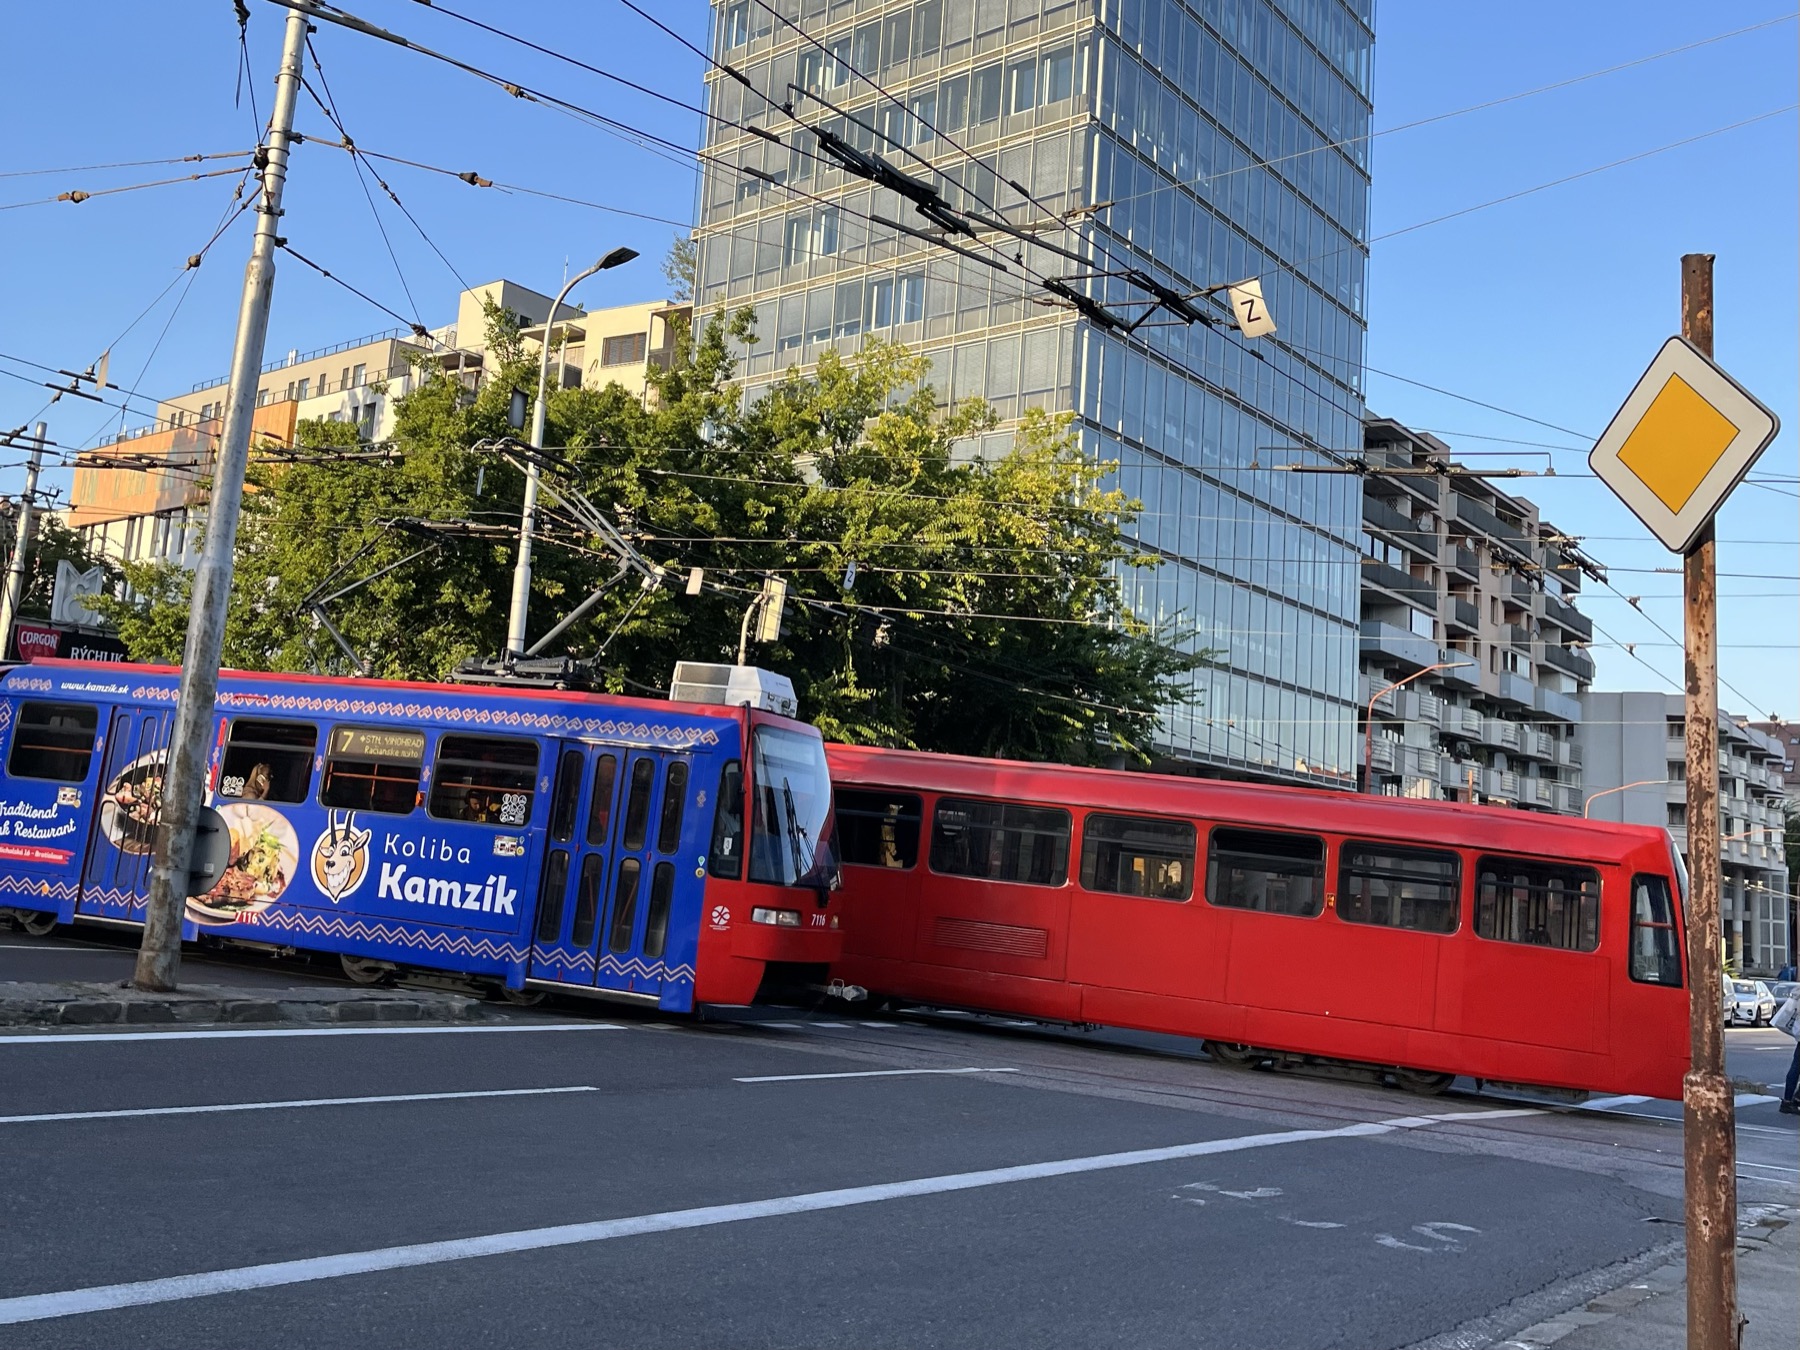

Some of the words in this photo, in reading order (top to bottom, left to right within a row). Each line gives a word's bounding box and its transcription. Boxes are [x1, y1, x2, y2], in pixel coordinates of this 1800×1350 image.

[1240, 298, 1261, 323] Z
[341, 731, 354, 757] 7
[14, 818, 76, 839] Restaurant
[384, 832, 471, 864] Koliba
[378, 862, 517, 916] Kamzík
[236, 911, 258, 924] 7116
[811, 914, 827, 926] 7116
